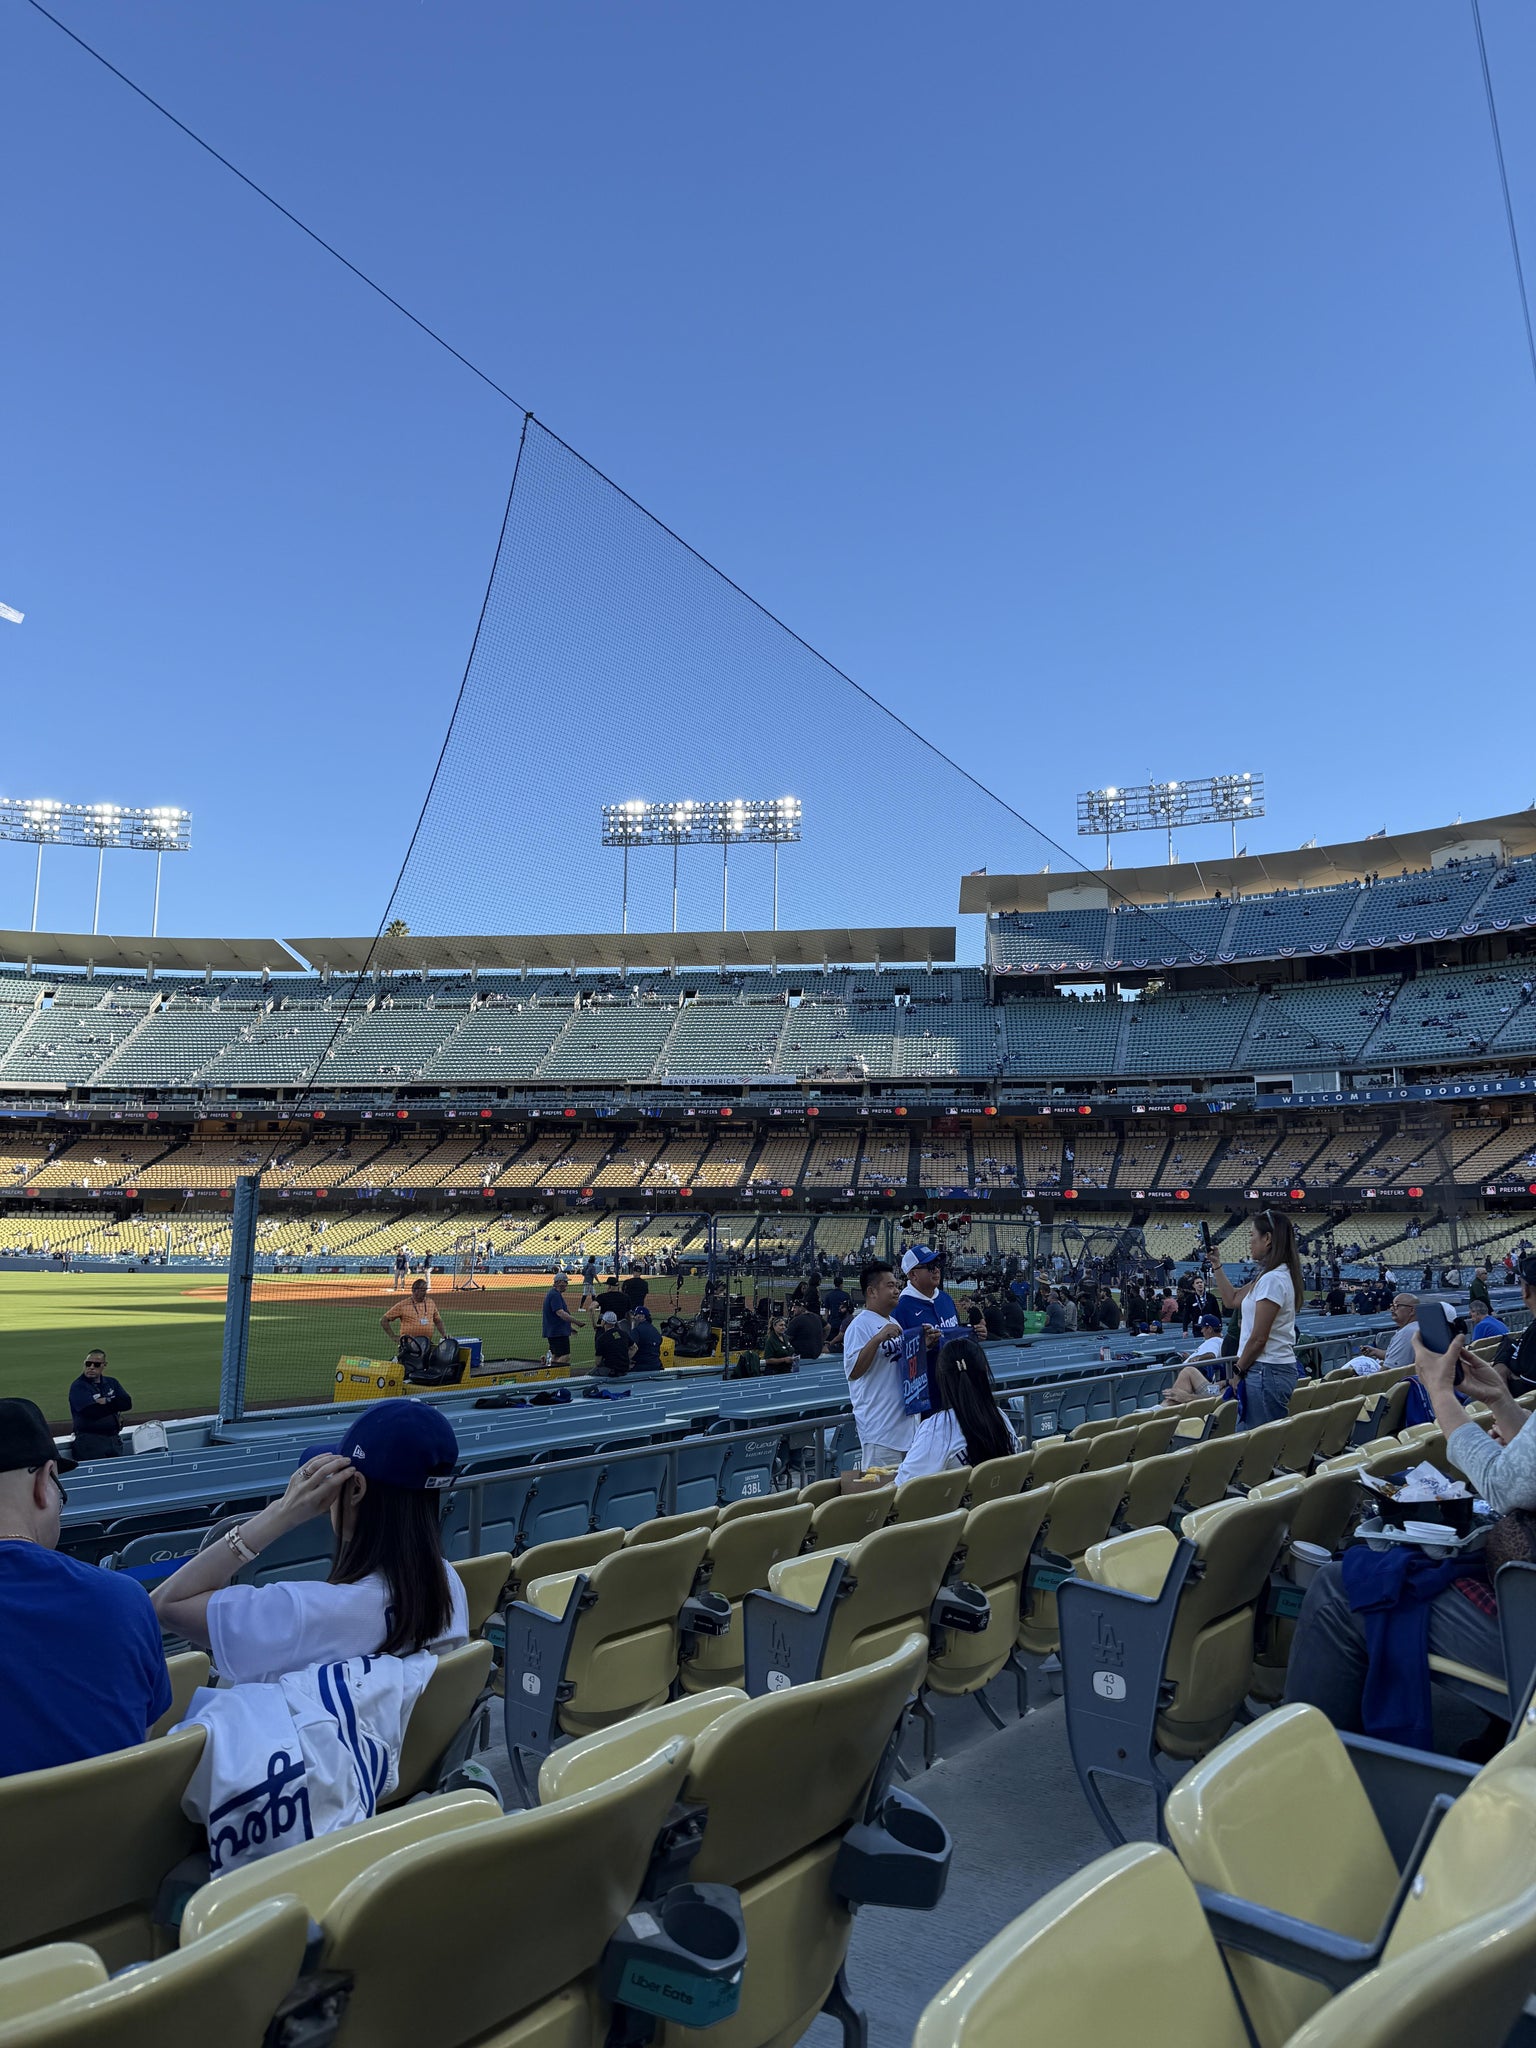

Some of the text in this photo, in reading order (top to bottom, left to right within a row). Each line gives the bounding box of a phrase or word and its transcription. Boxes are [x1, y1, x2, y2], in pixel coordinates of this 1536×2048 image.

[1282, 1093, 1371, 1104] WELCOME
[1388, 1090, 1408, 1098] TO
[1424, 1084, 1503, 1096] DODGER
[741, 1482, 762, 1496] 43BL
[528, 1675, 535, 1683] 43
[775, 1674, 784, 1683] 43
[1103, 1674, 1115, 1685] 43
[1106, 1685, 1113, 1695] D
[631, 1972, 661, 1994] Uber
[662, 1984, 695, 2005] Eats
